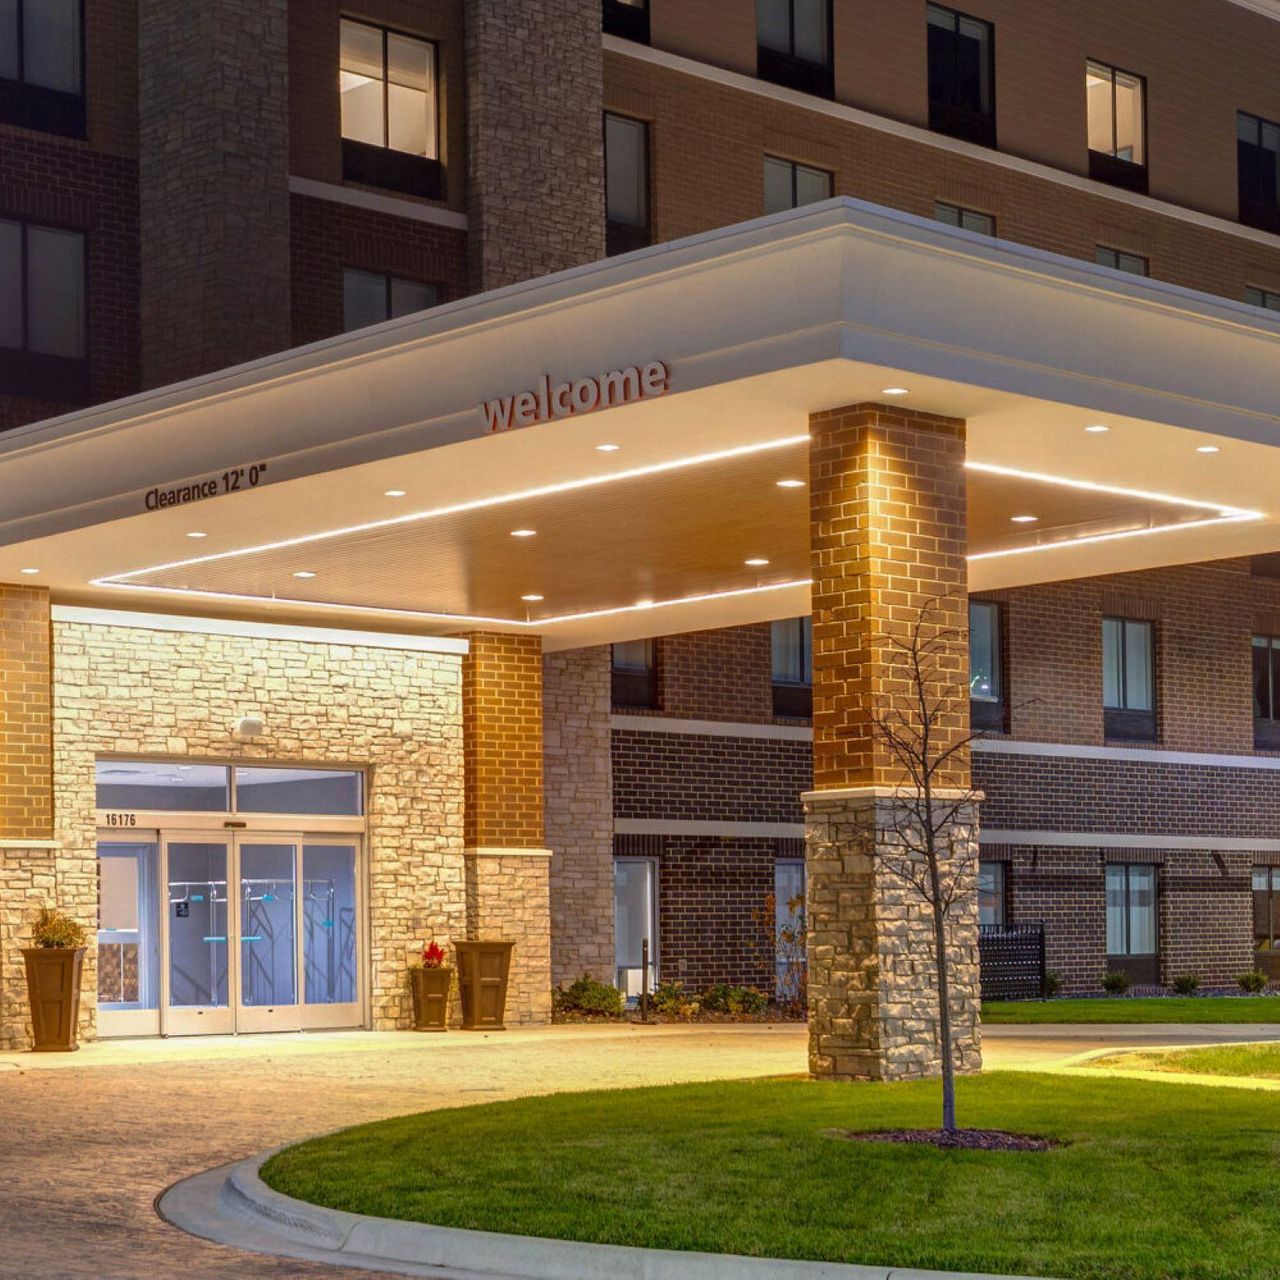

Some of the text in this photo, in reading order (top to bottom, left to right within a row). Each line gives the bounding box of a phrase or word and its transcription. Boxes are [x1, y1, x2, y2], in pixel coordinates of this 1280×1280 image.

[480, 360, 669, 432] welcome
[144, 463, 267, 511] Clearance 12' 0"
[105, 813, 136, 826] 16176
